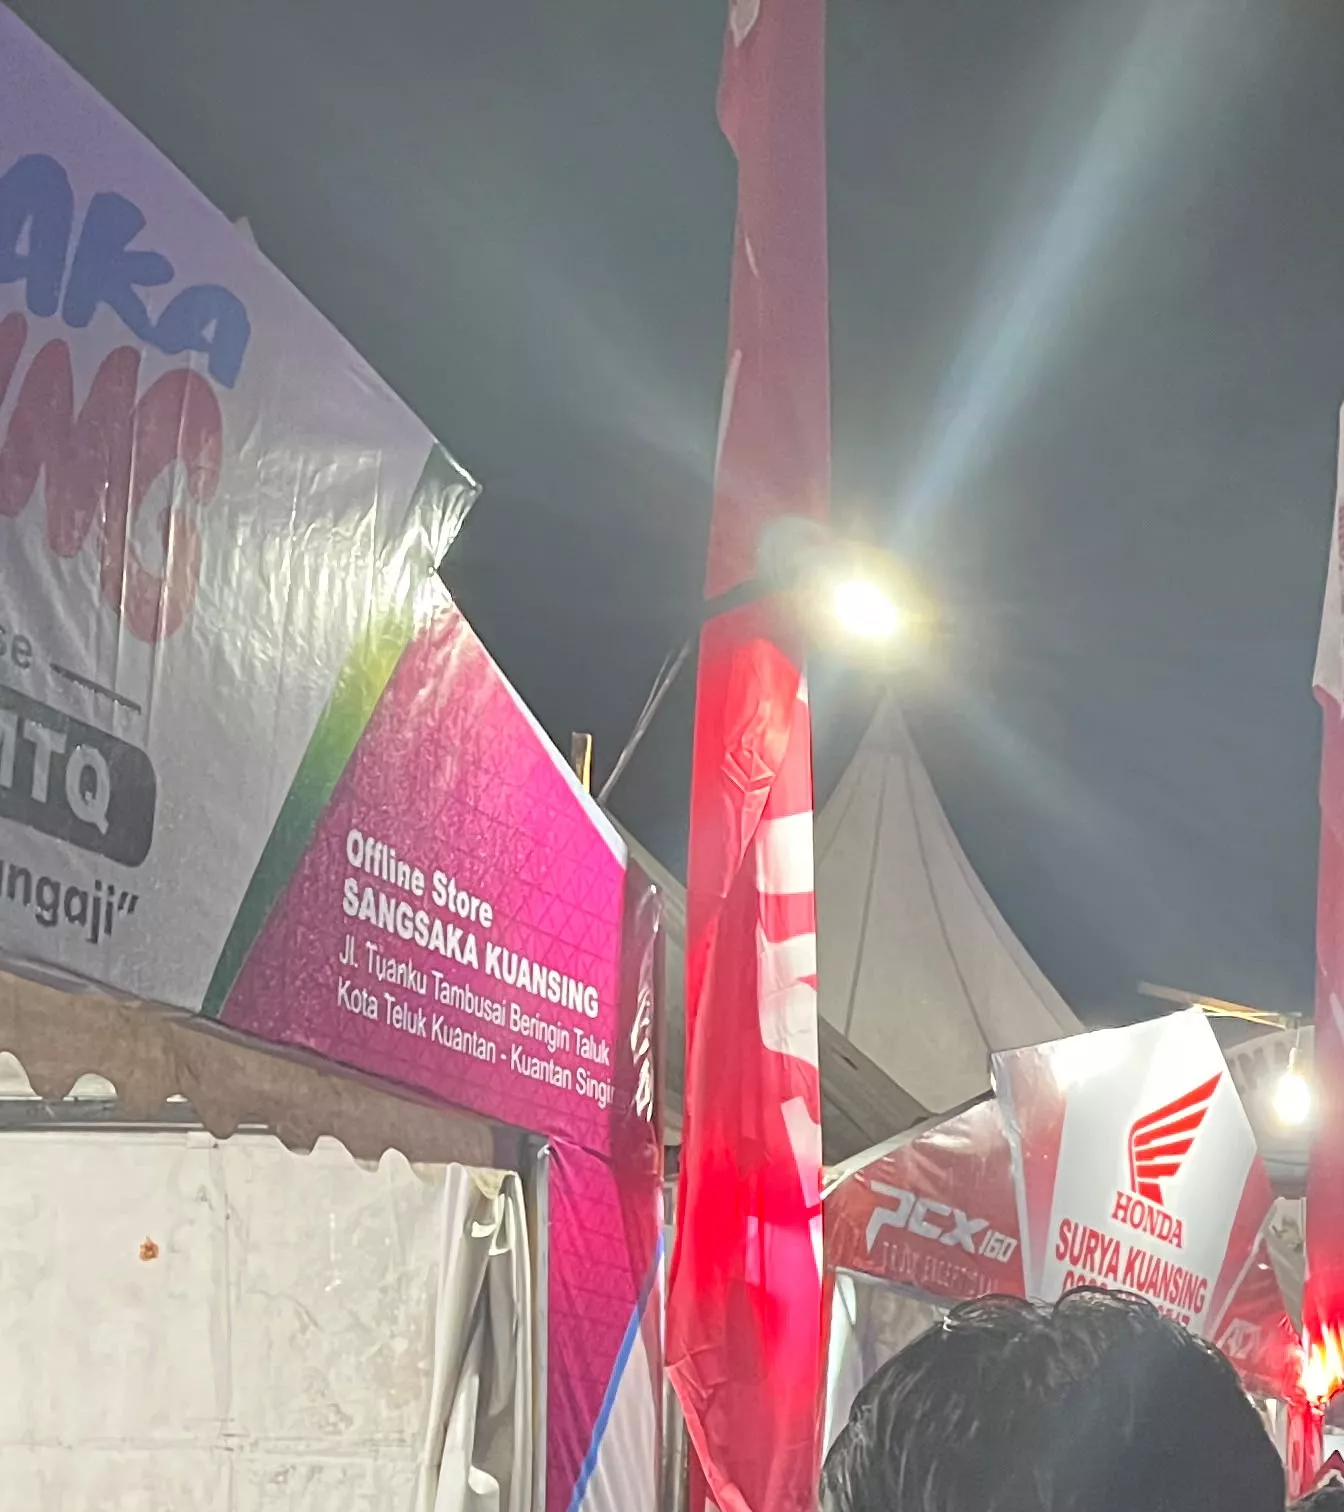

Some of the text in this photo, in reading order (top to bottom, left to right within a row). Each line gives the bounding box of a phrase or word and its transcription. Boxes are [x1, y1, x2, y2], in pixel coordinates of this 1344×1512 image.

[346, 829, 493, 928] Offline Store
[339, 933, 358, 968] Jl.
[366, 941, 427, 996] Tuanku
[431, 969, 507, 1027] Tambusai
[509, 1003, 570, 1053] Beringin
[343, 878, 599, 1019] SANGSAKA KUANSING
[337, 977, 378, 1021] Kota
[384, 992, 427, 1039] Teluk
[431, 1013, 497, 1064] Kuantan
[511, 1043, 572, 1090] Kuantan
[1055, 1217, 1121, 1282] SURYA
[1122, 1245, 1208, 1315] KUANSING
[1111, 1190, 1184, 1249] HONDA
